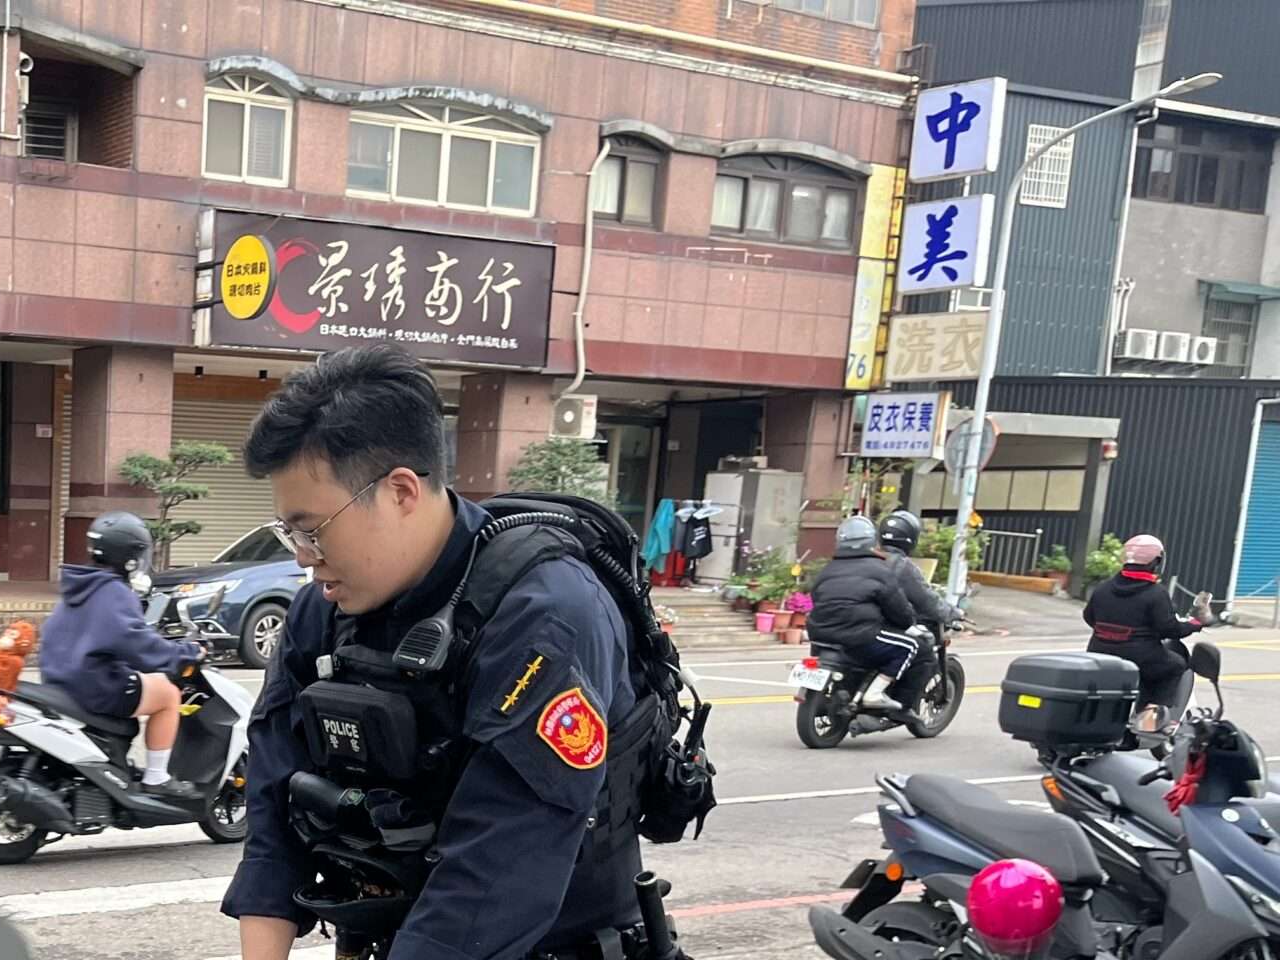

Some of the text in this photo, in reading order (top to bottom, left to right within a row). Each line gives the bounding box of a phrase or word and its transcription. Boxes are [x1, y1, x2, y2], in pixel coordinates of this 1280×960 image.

[893, 317, 984, 376] 洗衣
[868, 402, 933, 432] 皮衣保養
[323, 719, 360, 739] POLICE
